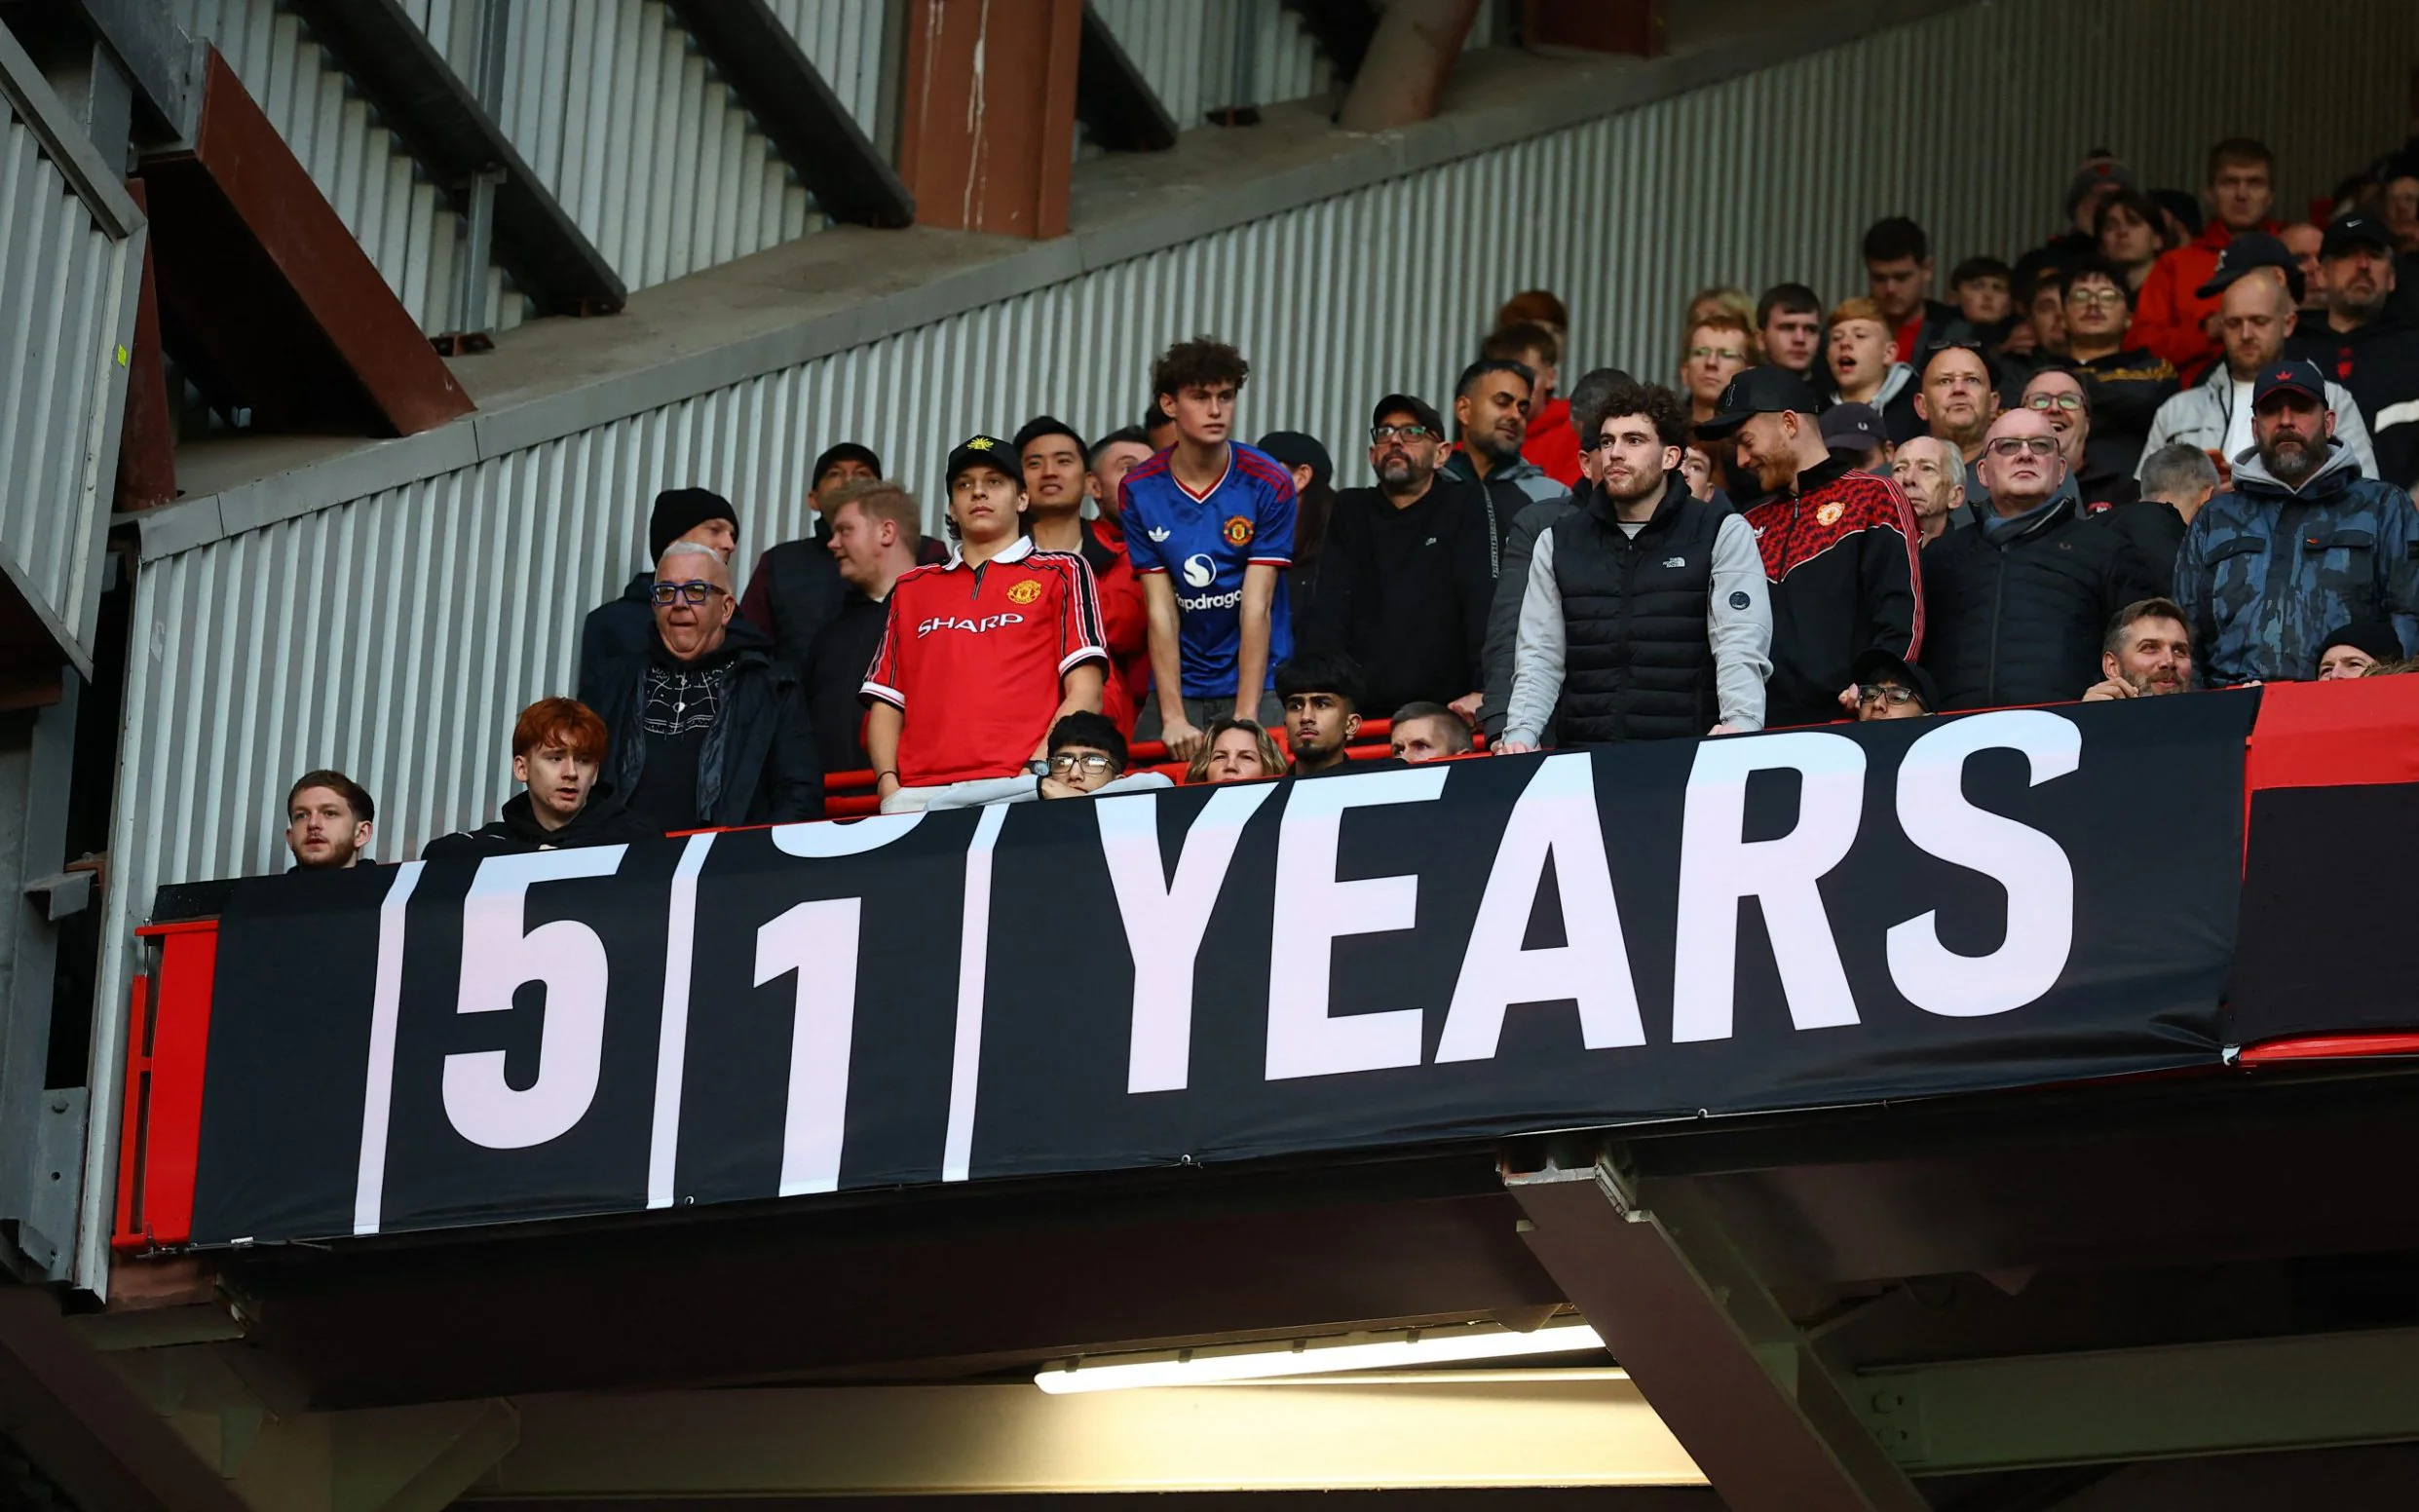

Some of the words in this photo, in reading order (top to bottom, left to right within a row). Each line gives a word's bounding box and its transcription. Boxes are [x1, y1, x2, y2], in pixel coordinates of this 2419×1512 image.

[1175, 589, 1243, 613] apdrago
[917, 613, 1025, 639] SHARP
[1095, 709, 2082, 1094] YEARS
